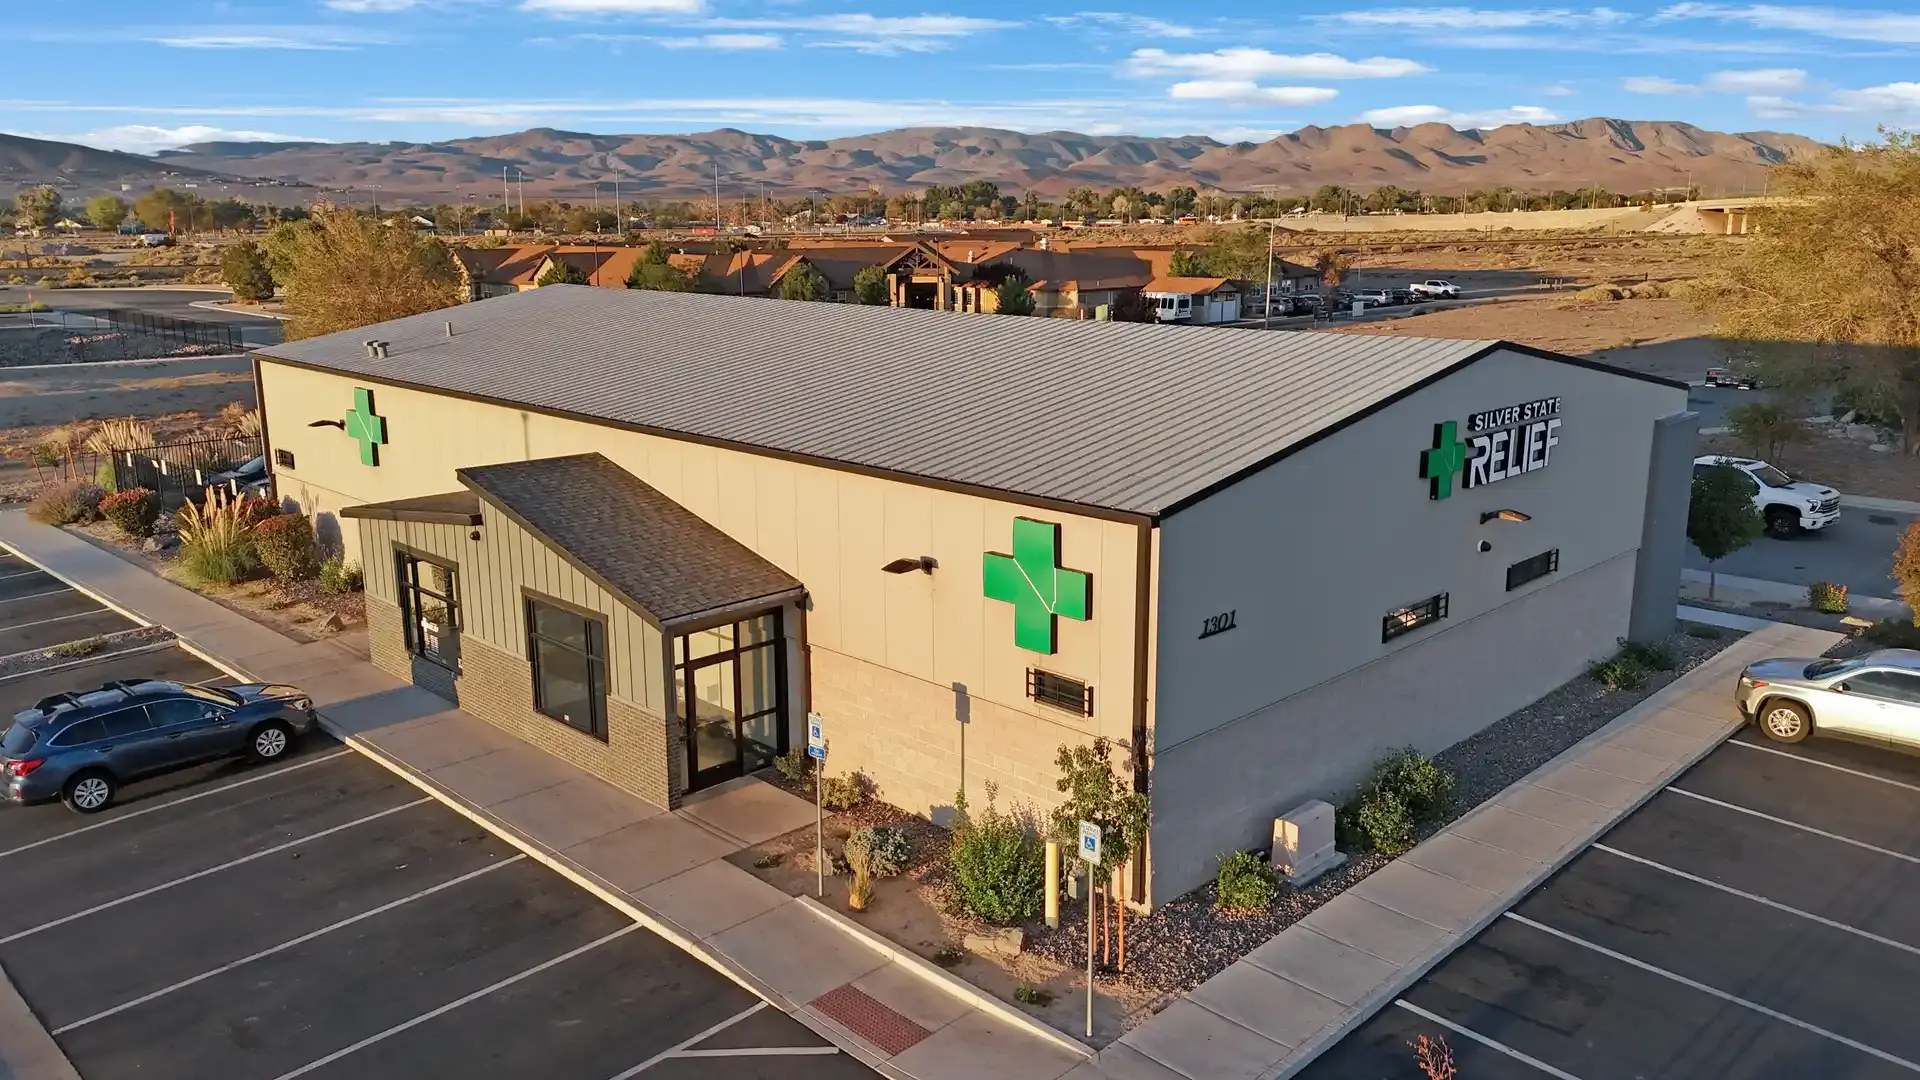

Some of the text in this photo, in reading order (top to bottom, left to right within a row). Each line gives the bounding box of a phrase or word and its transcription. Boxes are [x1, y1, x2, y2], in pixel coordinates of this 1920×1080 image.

[1473, 397, 1561, 431] SILVER STATE
[1468, 419, 1562, 488] RELIEF
[1199, 609, 1237, 640] 1301
